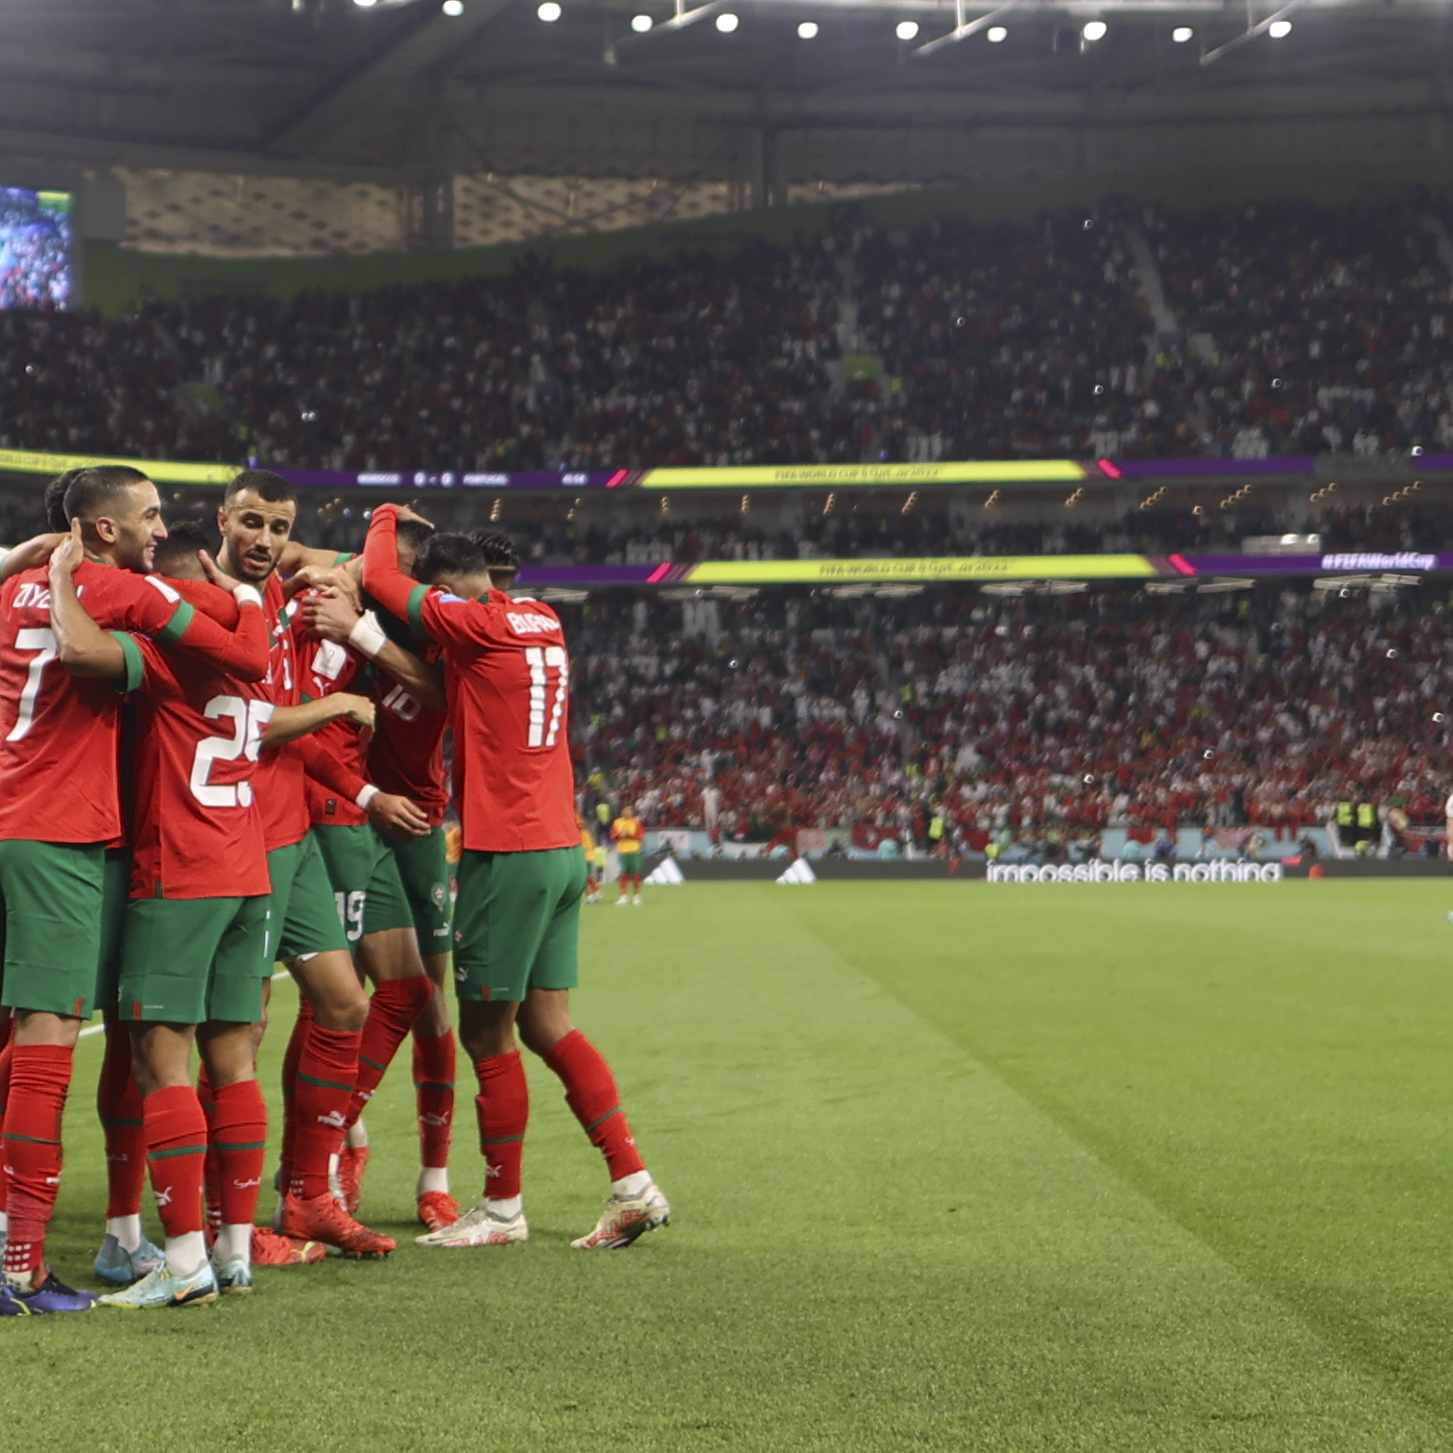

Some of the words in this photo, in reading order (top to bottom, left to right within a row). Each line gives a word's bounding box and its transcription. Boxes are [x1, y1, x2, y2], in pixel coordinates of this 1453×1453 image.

[5, 627, 58, 742] 7
[524, 646, 569, 747] 17
[986, 858, 1141, 883] impossible
[1144, 858, 1168, 882] is
[1173, 858, 1283, 882] nothing
[334, 890, 367, 941] 19
